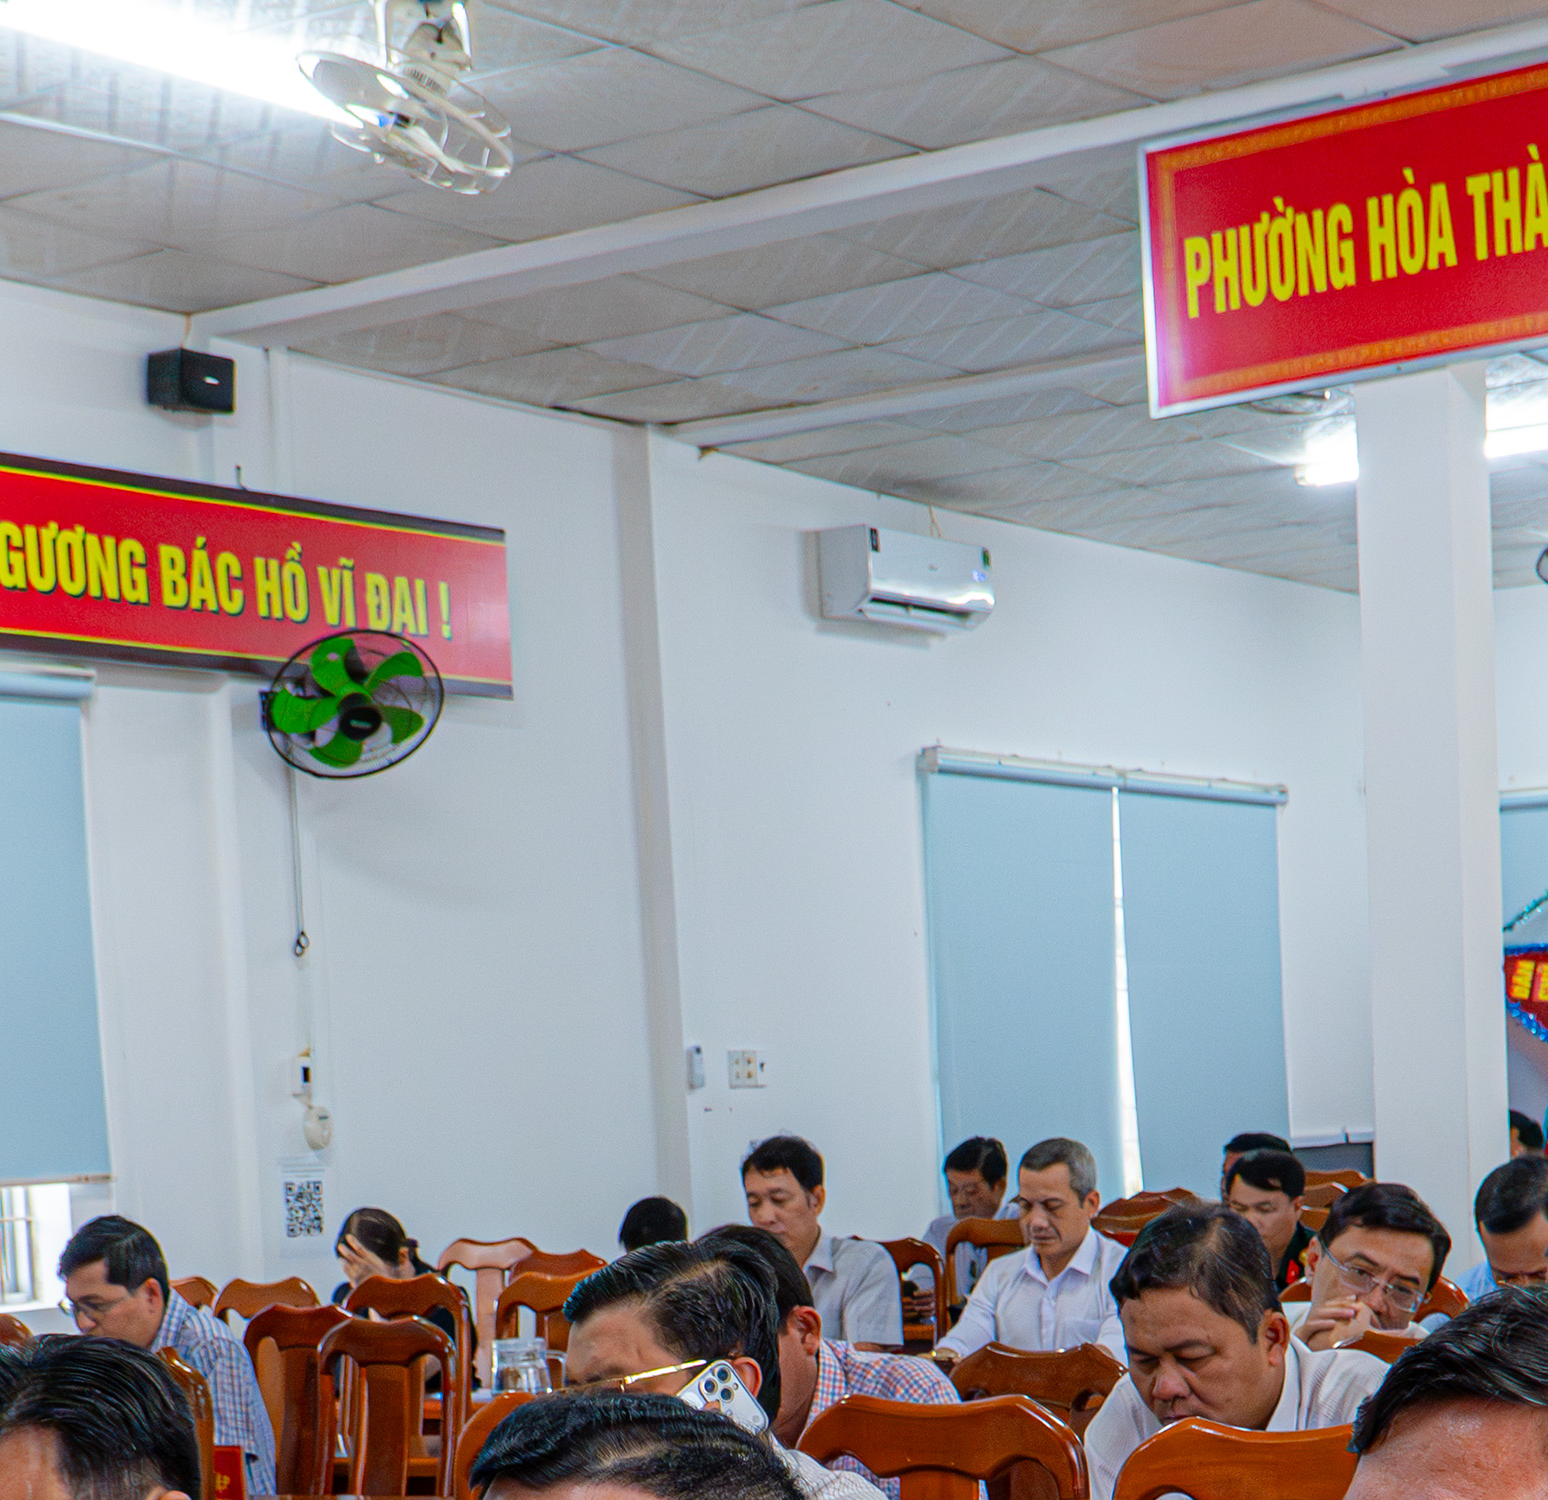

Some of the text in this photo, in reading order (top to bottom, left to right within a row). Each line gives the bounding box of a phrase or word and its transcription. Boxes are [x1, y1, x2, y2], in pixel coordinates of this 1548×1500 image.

[1183, 196, 1356, 319] PHƯỜNG
[1366, 167, 1458, 282] HÒA
[158, 535, 245, 615] BÁC
[253, 541, 309, 621] HỒ
[316, 556, 356, 627] VĨ
